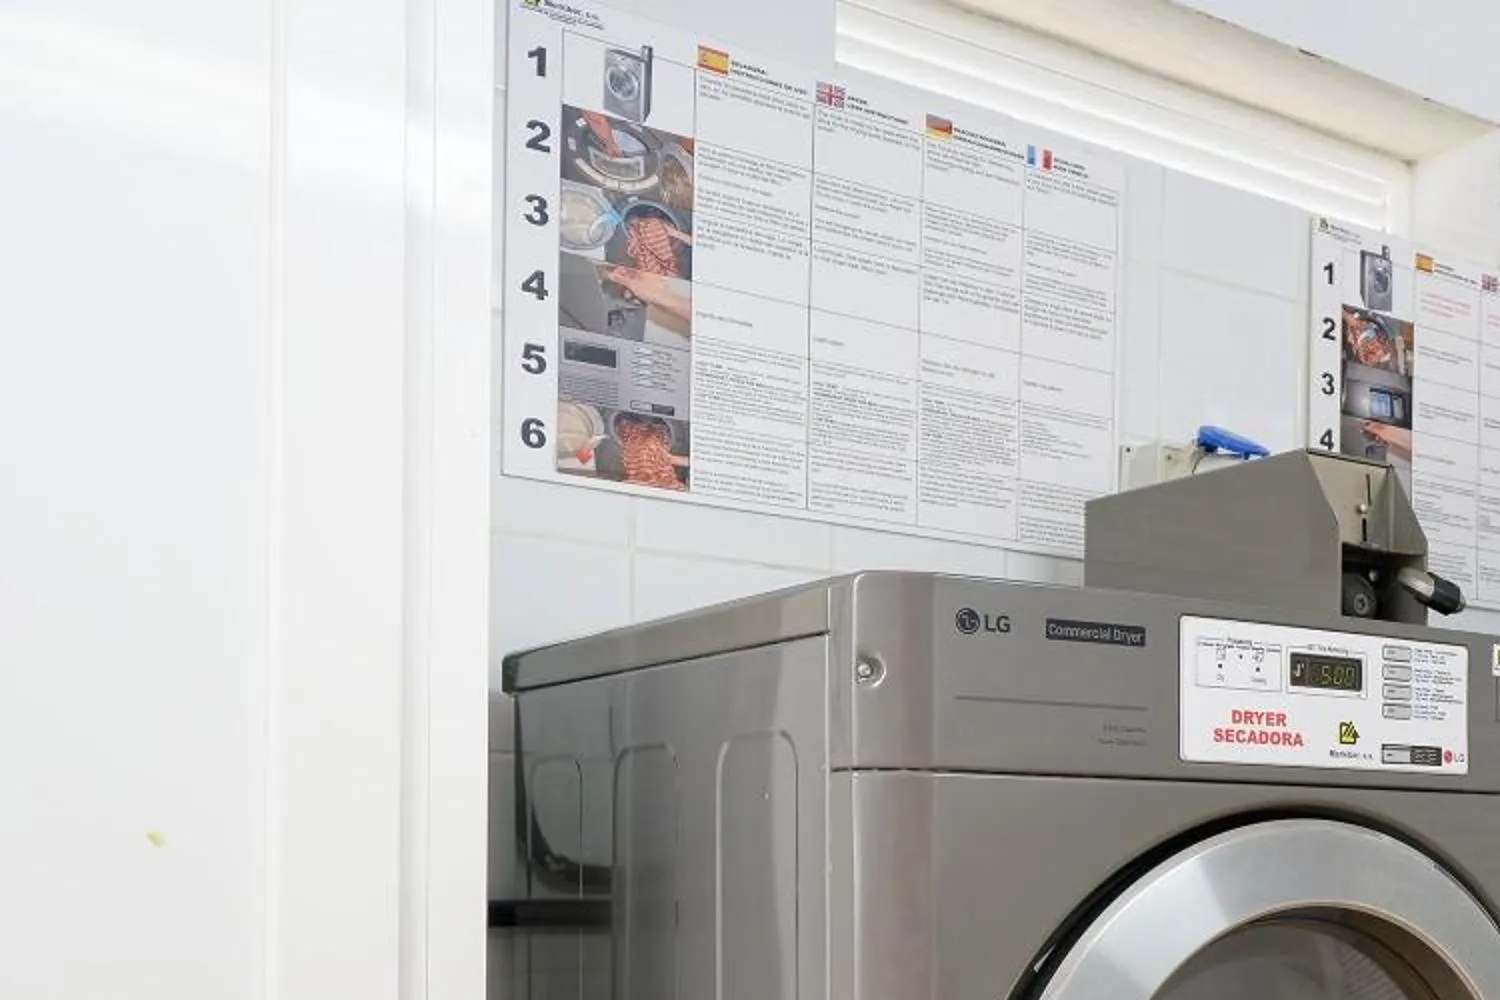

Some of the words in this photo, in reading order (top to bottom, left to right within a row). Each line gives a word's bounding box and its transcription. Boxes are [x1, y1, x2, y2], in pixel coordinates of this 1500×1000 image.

[527, 46, 547, 77] 1
[525, 119, 551, 153] 2
[524, 194, 549, 227] 3
[521, 269, 549, 301] 4
[1323, 261, 1335, 286] 1
[1322, 317, 1337, 341] 2
[521, 342, 547, 375] 5
[1321, 372, 1335, 396] 3
[521, 417, 547, 449] 6
[1319, 428, 1335, 451] 4
[984, 614, 1012, 633] LG
[1049, 623, 1111, 641] Commercial
[1112, 627, 1144, 645] Dryer
[1231, 709, 1288, 727] DRYER
[1213, 728, 1304, 747] SECADORA
